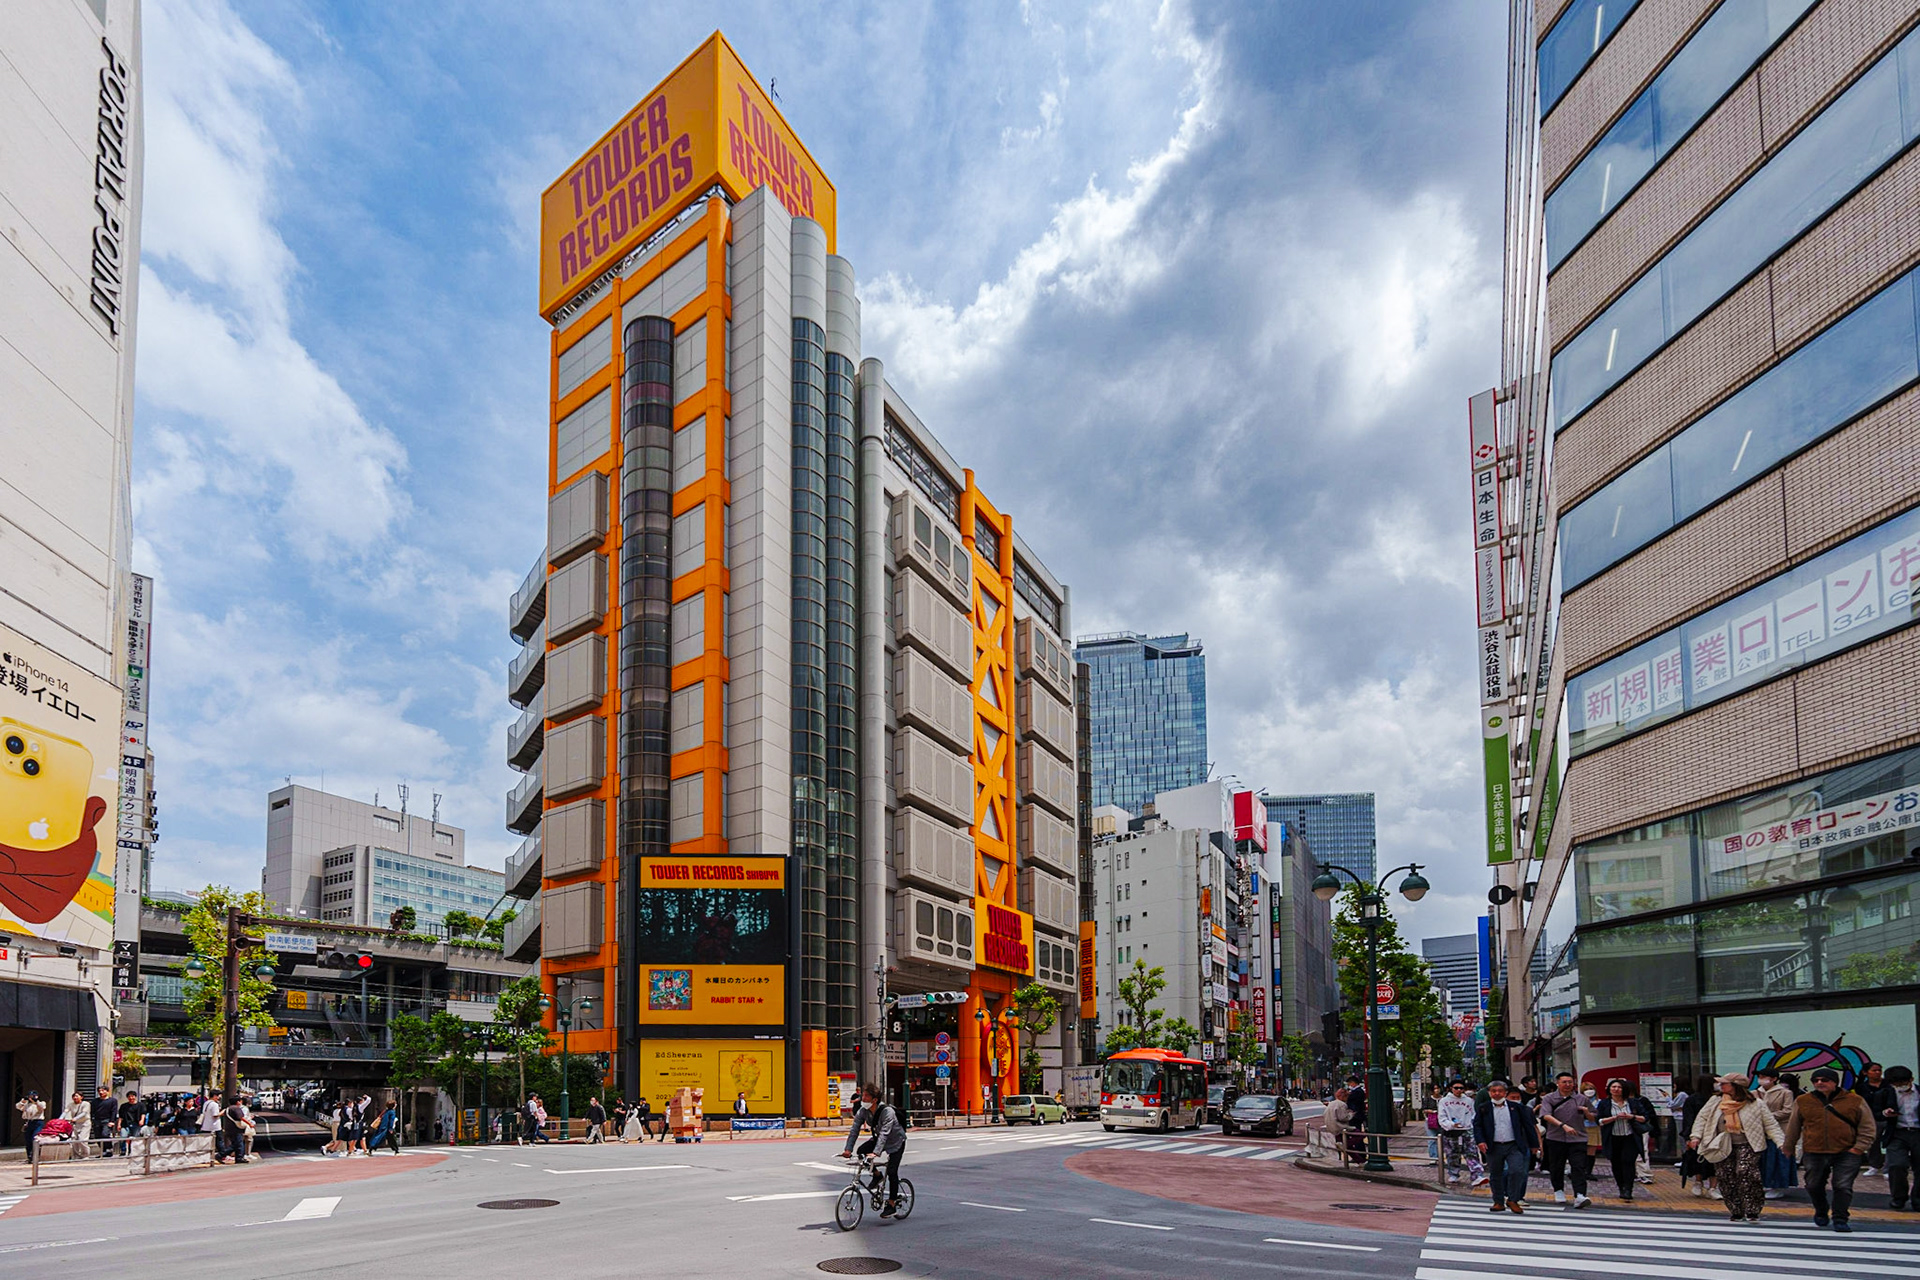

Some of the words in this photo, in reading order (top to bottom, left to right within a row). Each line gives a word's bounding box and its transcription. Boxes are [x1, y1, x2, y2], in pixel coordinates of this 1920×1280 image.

[95, 37, 130, 201] PORTAL
[569, 94, 670, 220] TOWER
[737, 82, 815, 220] TOWER
[559, 132, 694, 286] RECORDS
[90, 195, 124, 337] POINT
[1478, 470, 1496, 542] 日本生命
[1783, 629, 1821, 652] TEL
[13, 655, 55, 686] iPhone
[57, 678, 69, 693] 14
[1484, 630, 1501, 698] 渋谷公証役場
[124, 757, 141, 767] 4F
[1492, 783, 1506, 852] 日本政策金融公庫
[1723, 790, 1919, 855] 国の教育ローンお
[649, 864, 690, 880] TOWER
[693, 864, 744, 880] RECORDS
[745, 870, 779, 881] SHIBUYA
[987, 904, 1022, 940] TOWER
[984, 932, 1029, 971] RECORDS
[1081, 937, 1093, 965] TOWER
[704, 976, 770, 984] 水曜日のカンパネラ
[1081, 966, 1093, 1002] RECORDS
[711, 996, 736, 1004] RABBIT
[737, 996, 755, 1004] STAR
[1254, 999, 1264, 1041] 東日本銀行
[655, 1051, 666, 1059] Ed
[666, 1051, 703, 1059] Sheeran
